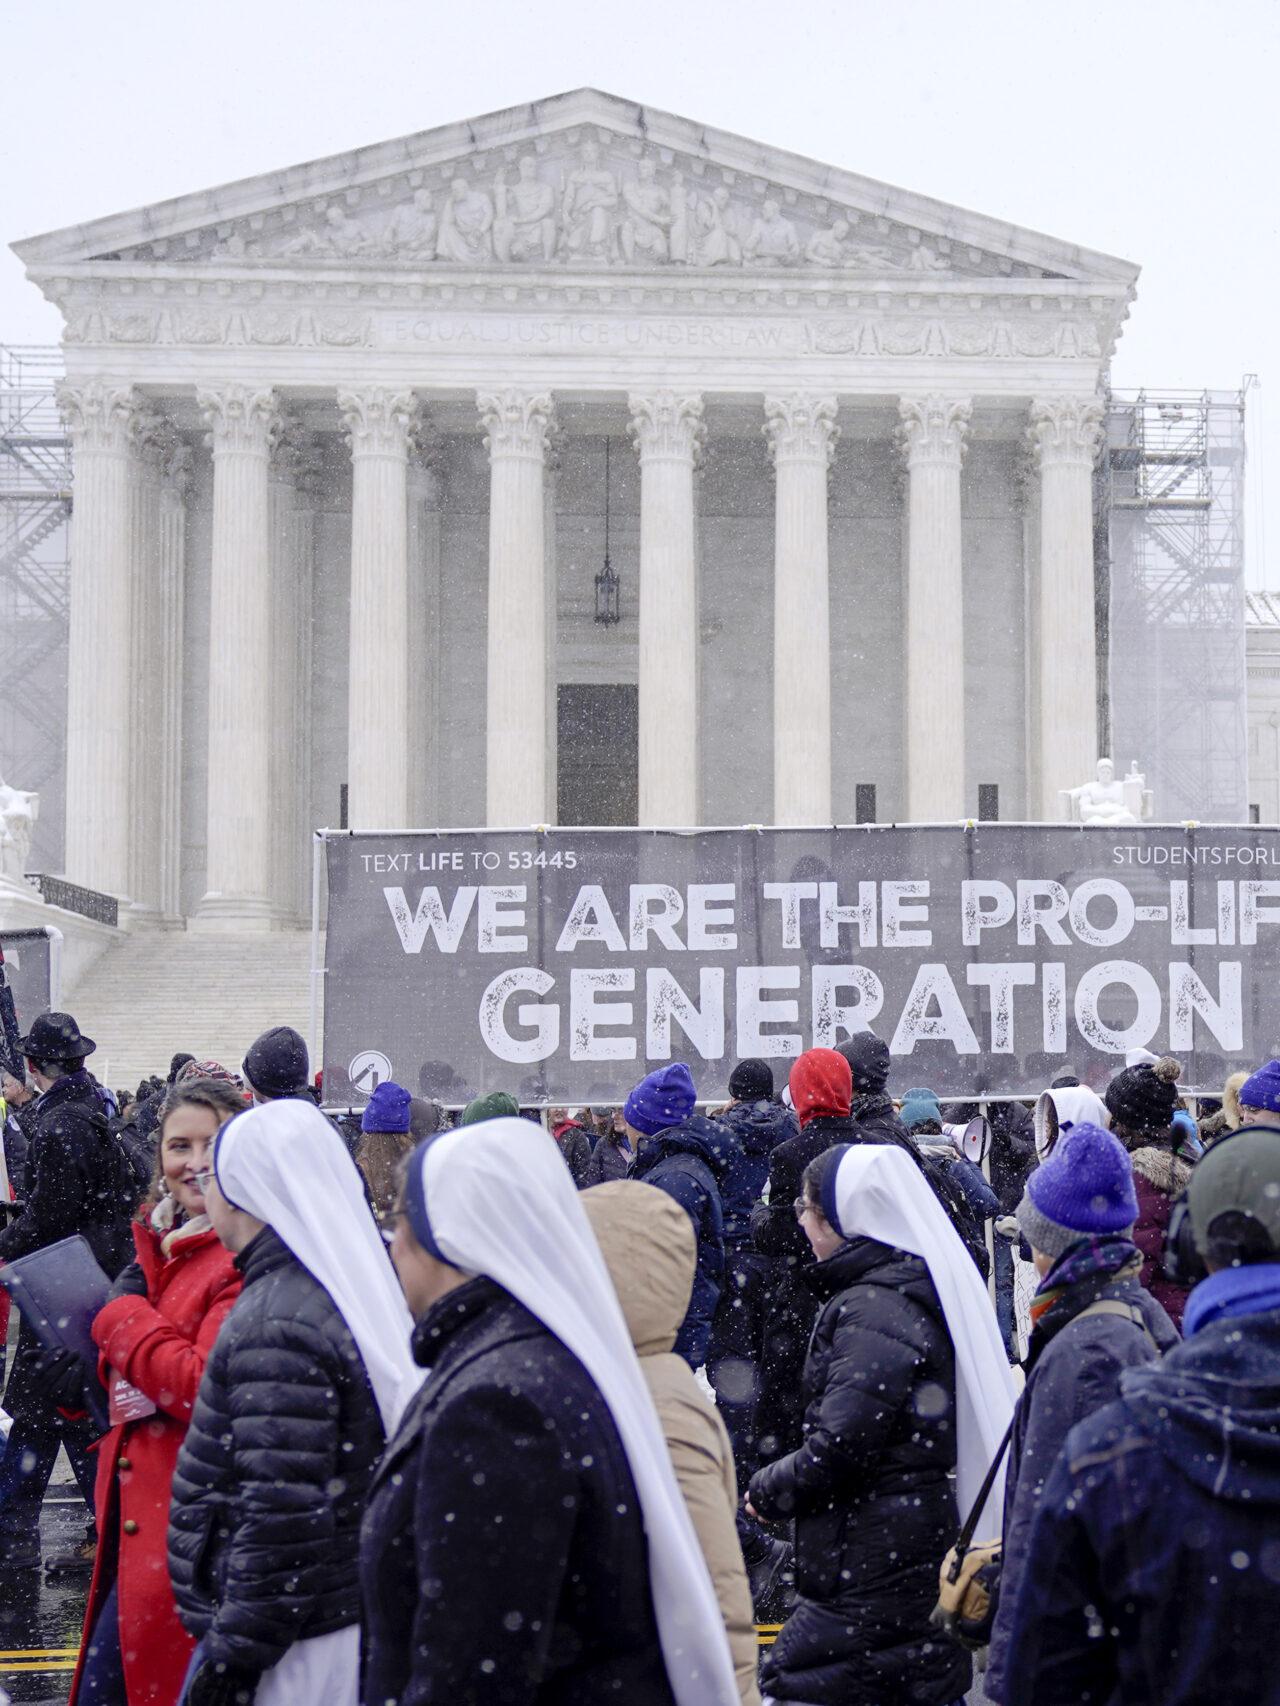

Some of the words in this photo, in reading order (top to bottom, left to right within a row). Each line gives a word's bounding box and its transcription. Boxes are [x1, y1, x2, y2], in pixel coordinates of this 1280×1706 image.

[501, 323, 609, 345] JUSTICE
[625, 325, 715, 346] UNDER
[731, 326, 784, 346] LAW
[361, 854, 413, 873] TEXT
[419, 852, 463, 871] LIFE
[472, 852, 501, 871] TO
[507, 850, 578, 870] 53445
[383, 885, 528, 954] WE
[555, 883, 738, 952] ARE
[763, 880, 932, 949] THE
[479, 959, 1244, 1064] GENERATION
